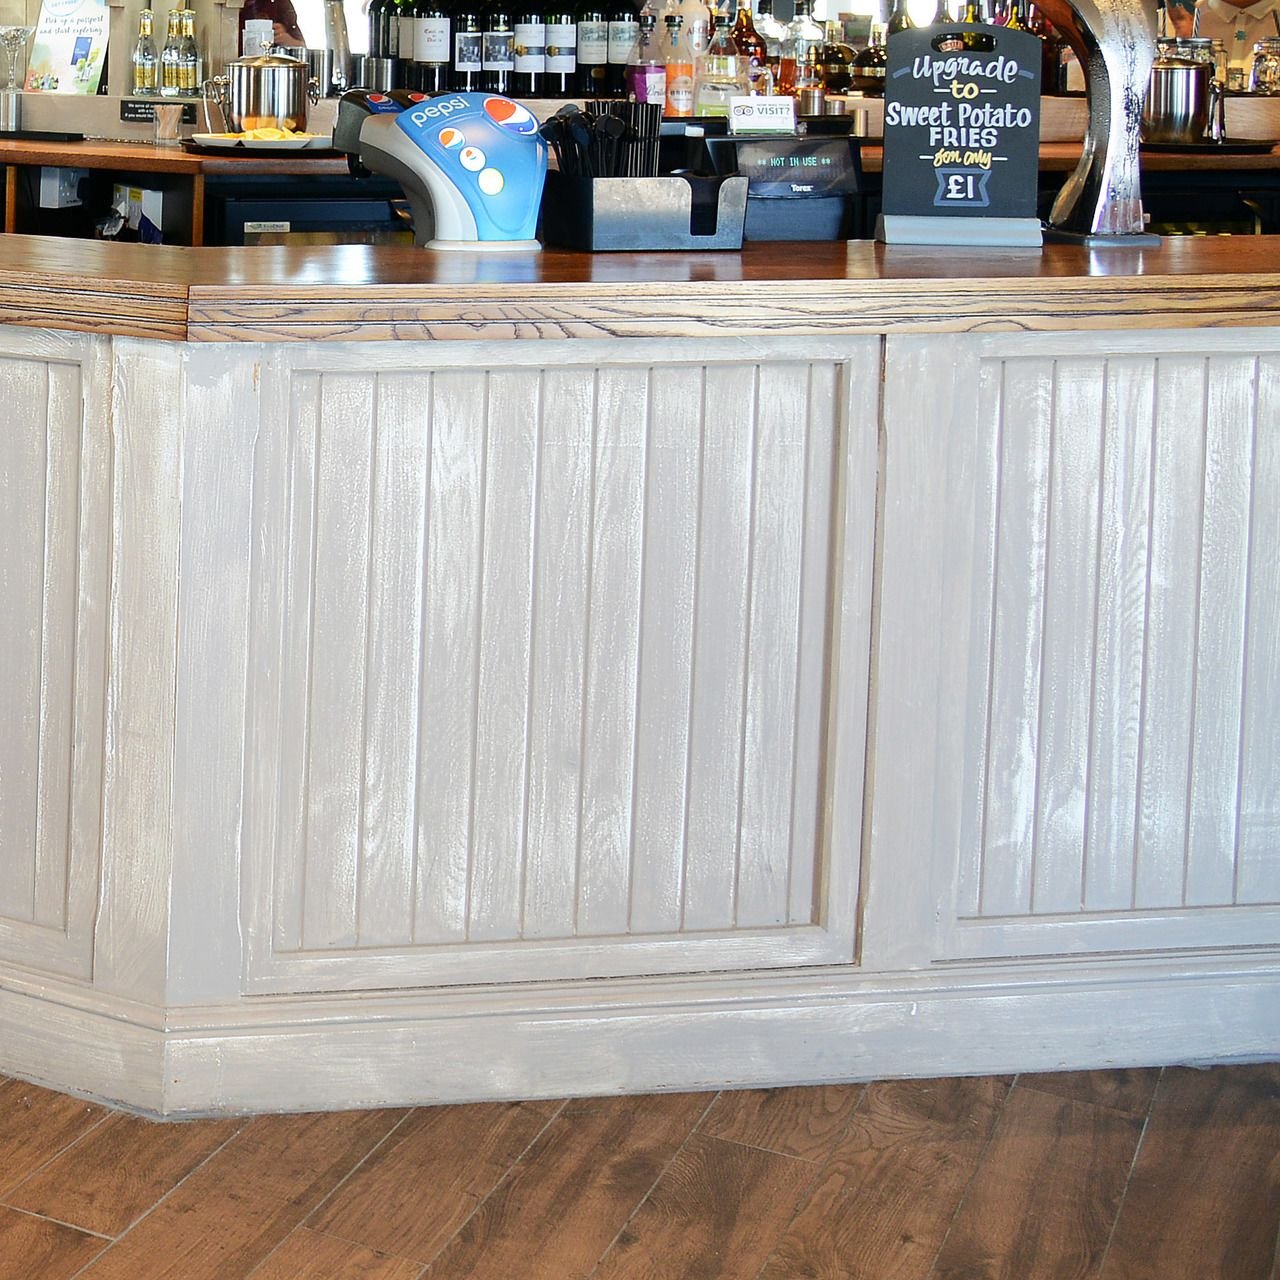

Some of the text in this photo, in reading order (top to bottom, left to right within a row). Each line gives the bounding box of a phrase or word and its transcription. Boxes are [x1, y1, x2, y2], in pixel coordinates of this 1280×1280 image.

[912, 55, 1018, 86] Upgrade
[950, 79, 979, 99] to
[410, 95, 470, 128] pepsi
[757, 107, 790, 115] VISIT?
[885, 102, 1032, 128] Sweet Potato
[929, 127, 998, 147] FRIES
[770, 157, 817, 166] NOT IN USE
[933, 148, 992, 170] for only
[791, 184, 812, 192] Torex
[946, 174, 974, 199] £1
